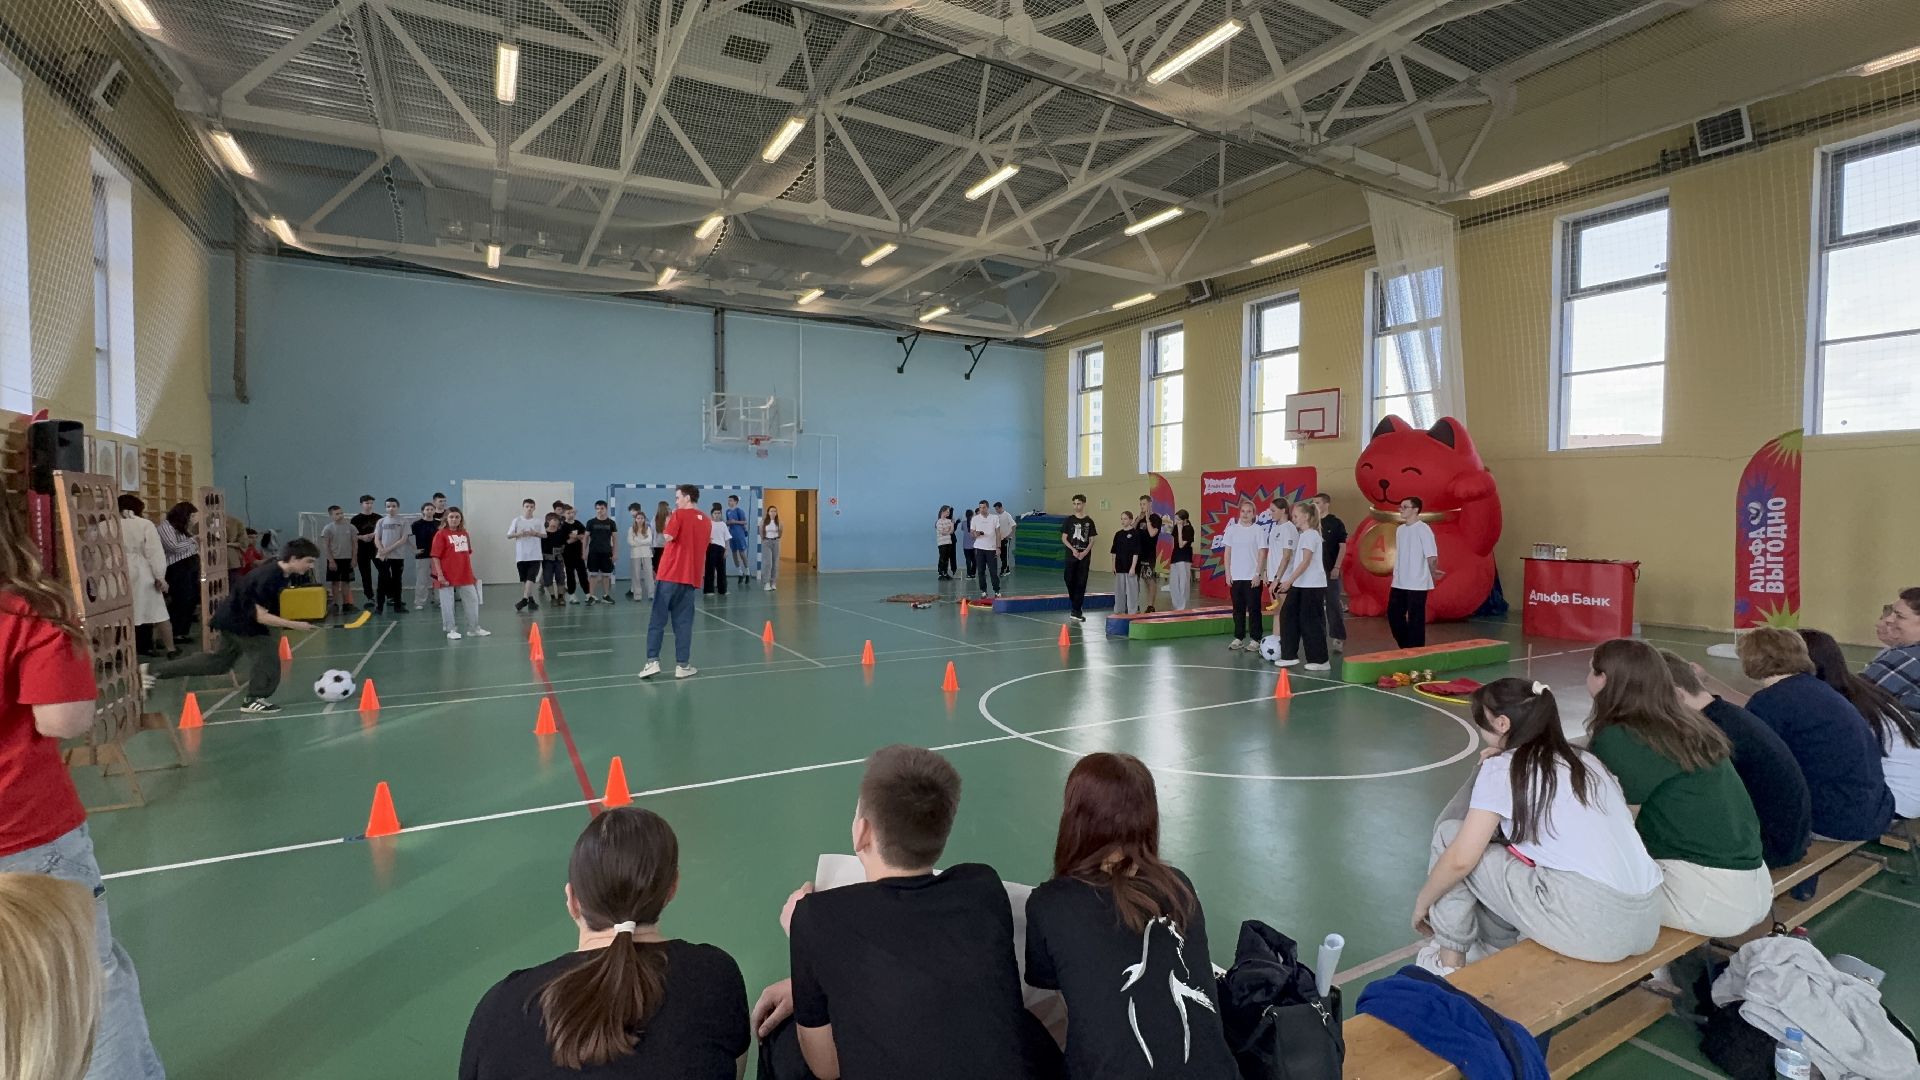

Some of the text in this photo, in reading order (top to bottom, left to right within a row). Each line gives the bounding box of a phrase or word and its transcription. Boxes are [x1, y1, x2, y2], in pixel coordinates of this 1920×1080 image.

[1749, 527, 1765, 592] АЛЬФА
[1766, 497, 1786, 593] ВЫГОДНО
[1529, 589, 1611, 607] Альфа Банк
